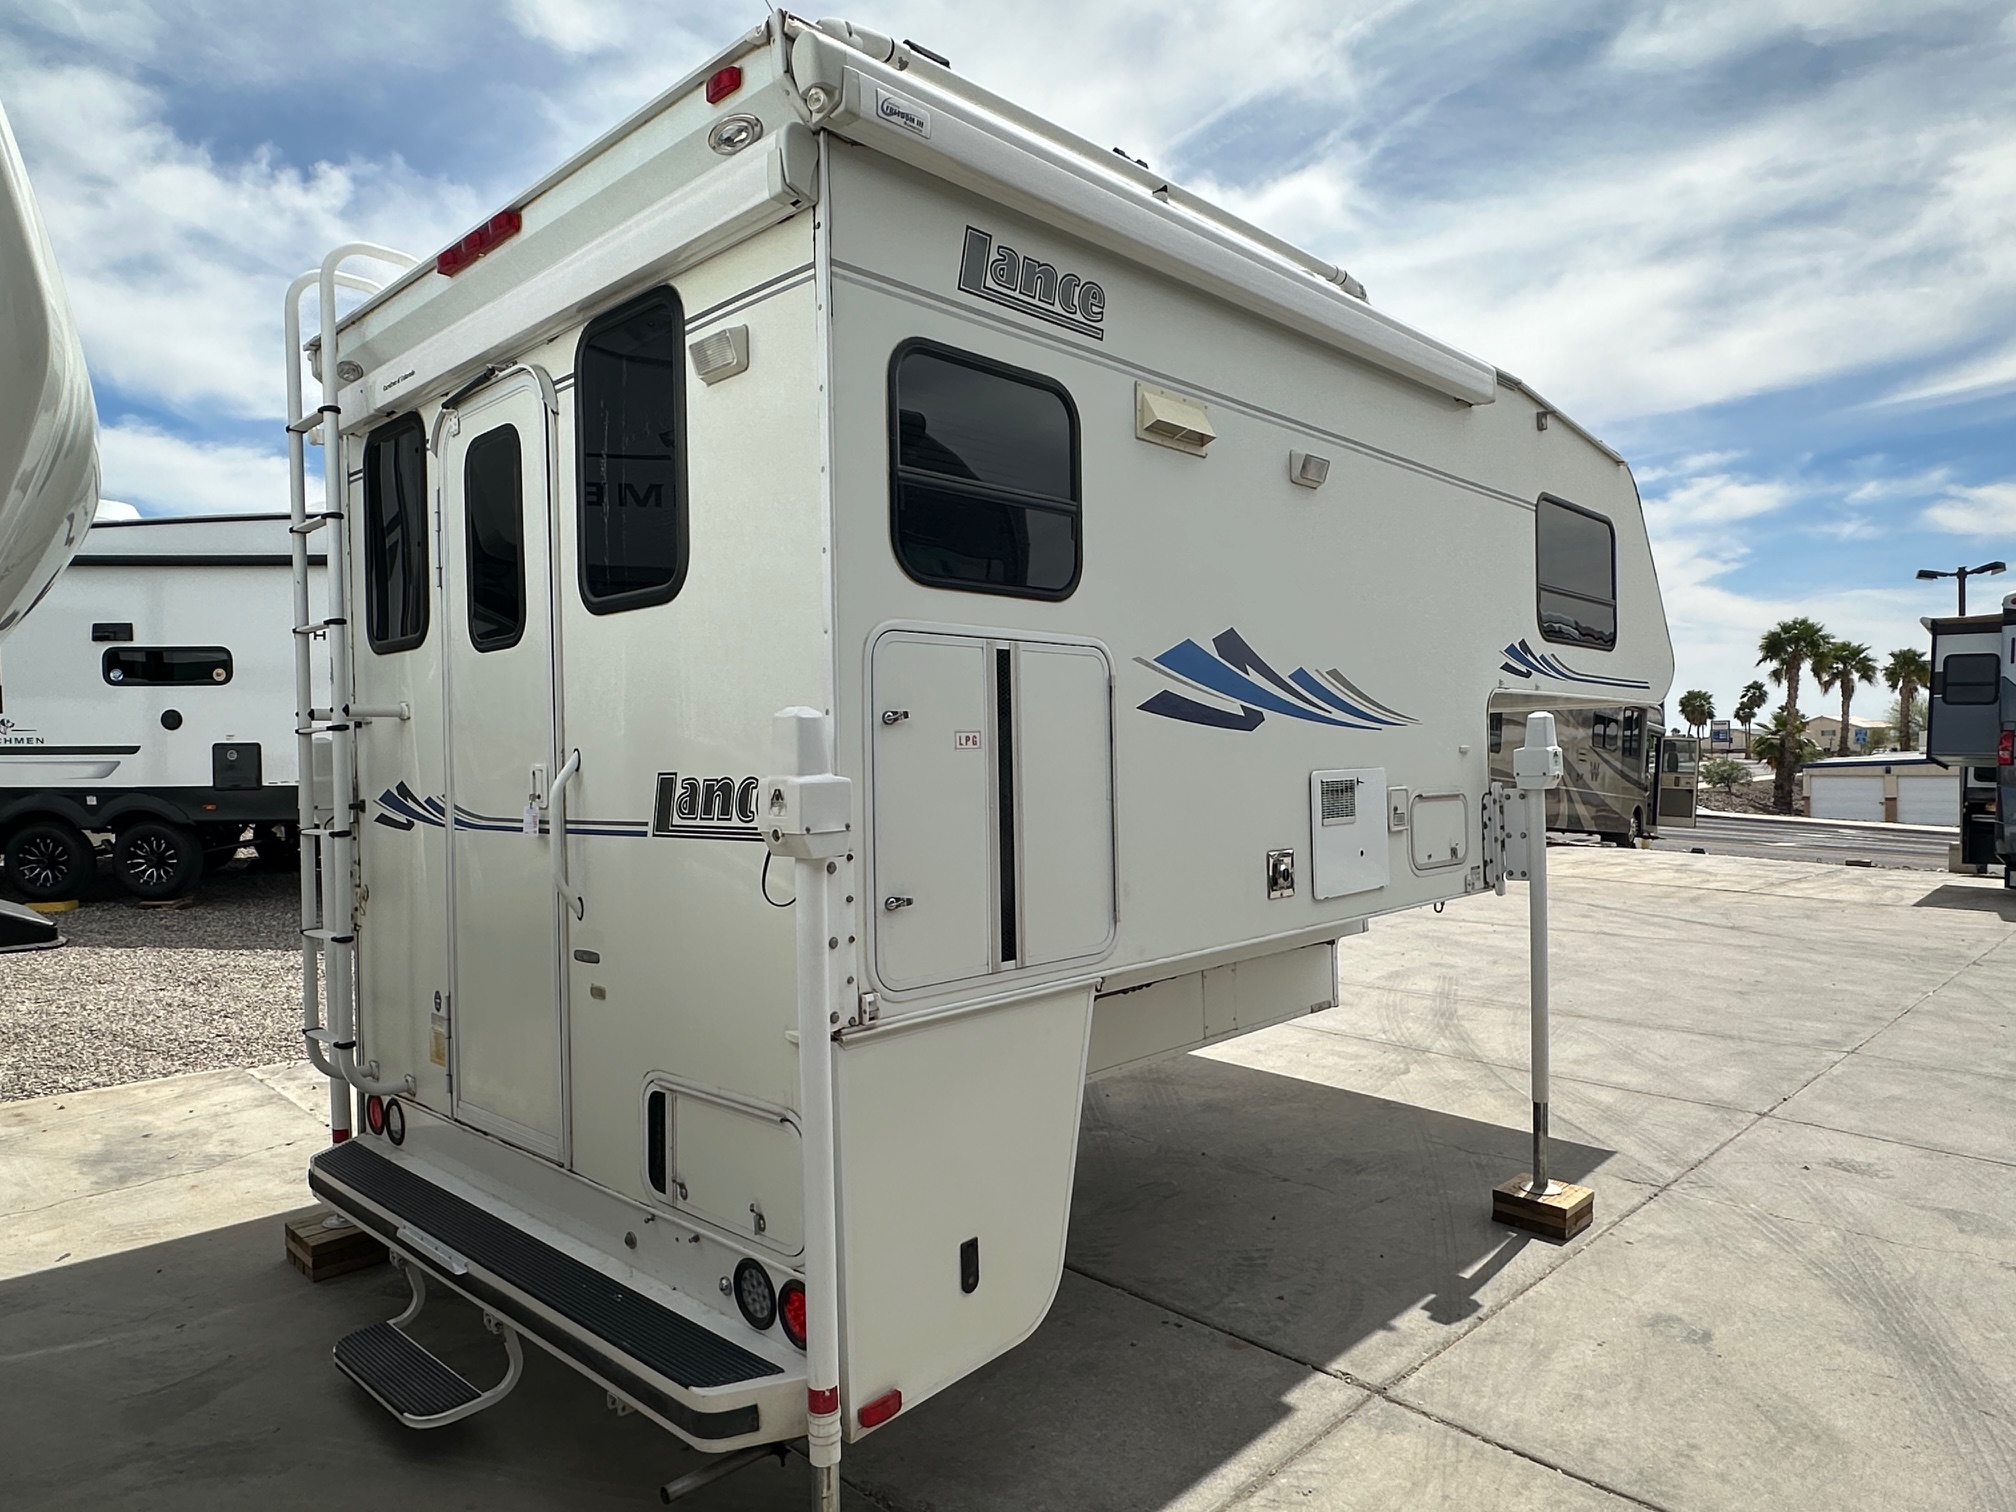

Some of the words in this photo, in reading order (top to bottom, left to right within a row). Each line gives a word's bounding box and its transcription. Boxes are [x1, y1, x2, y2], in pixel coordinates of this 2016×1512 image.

[958, 224, 1106, 341] Lance
[958, 734, 978, 747] LPG
[653, 771, 762, 842] Lanc
